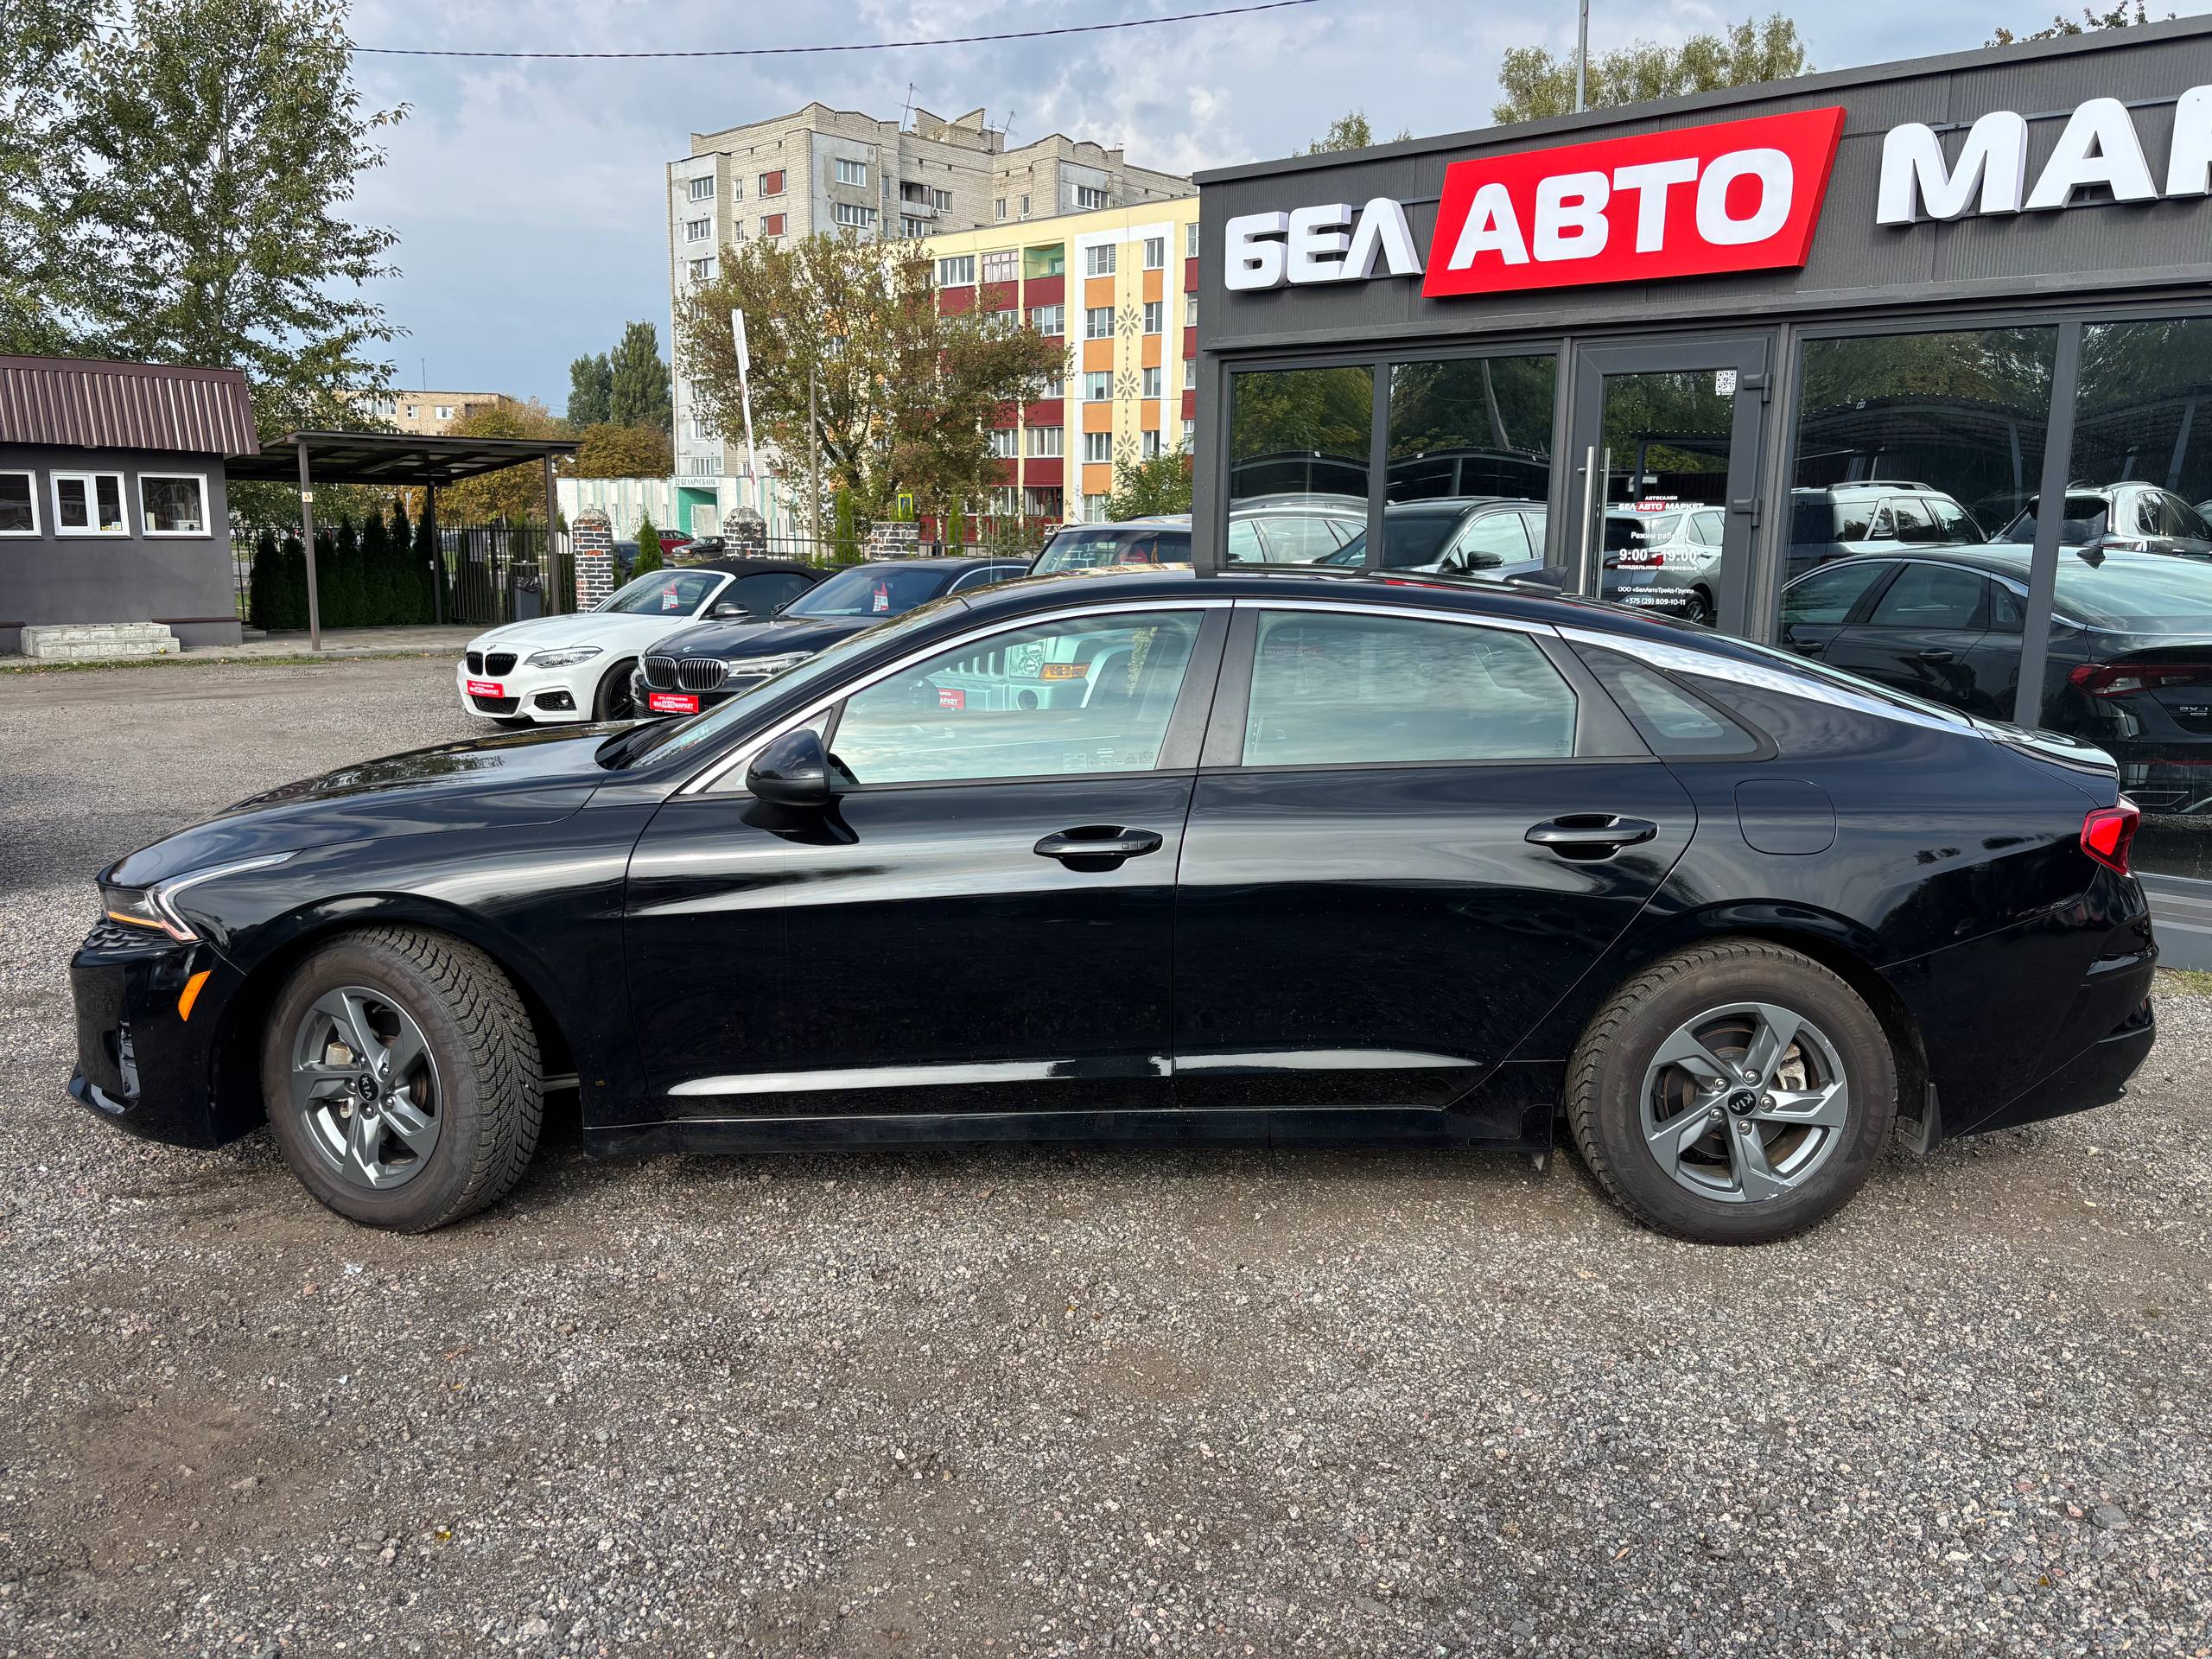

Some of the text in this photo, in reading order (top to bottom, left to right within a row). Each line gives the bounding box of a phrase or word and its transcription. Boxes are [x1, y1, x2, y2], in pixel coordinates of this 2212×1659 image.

[1224, 197, 1426, 291] БЕЛ
[1447, 148, 1794, 270] АВТО
[1638, 502, 1663, 511] АВТО
[1618, 548, 1648, 561] 9:00
[1662, 550, 1697, 562] 19:00
[360, 1076, 372, 1099] KIA
[1731, 1093, 1754, 1112] KIA
